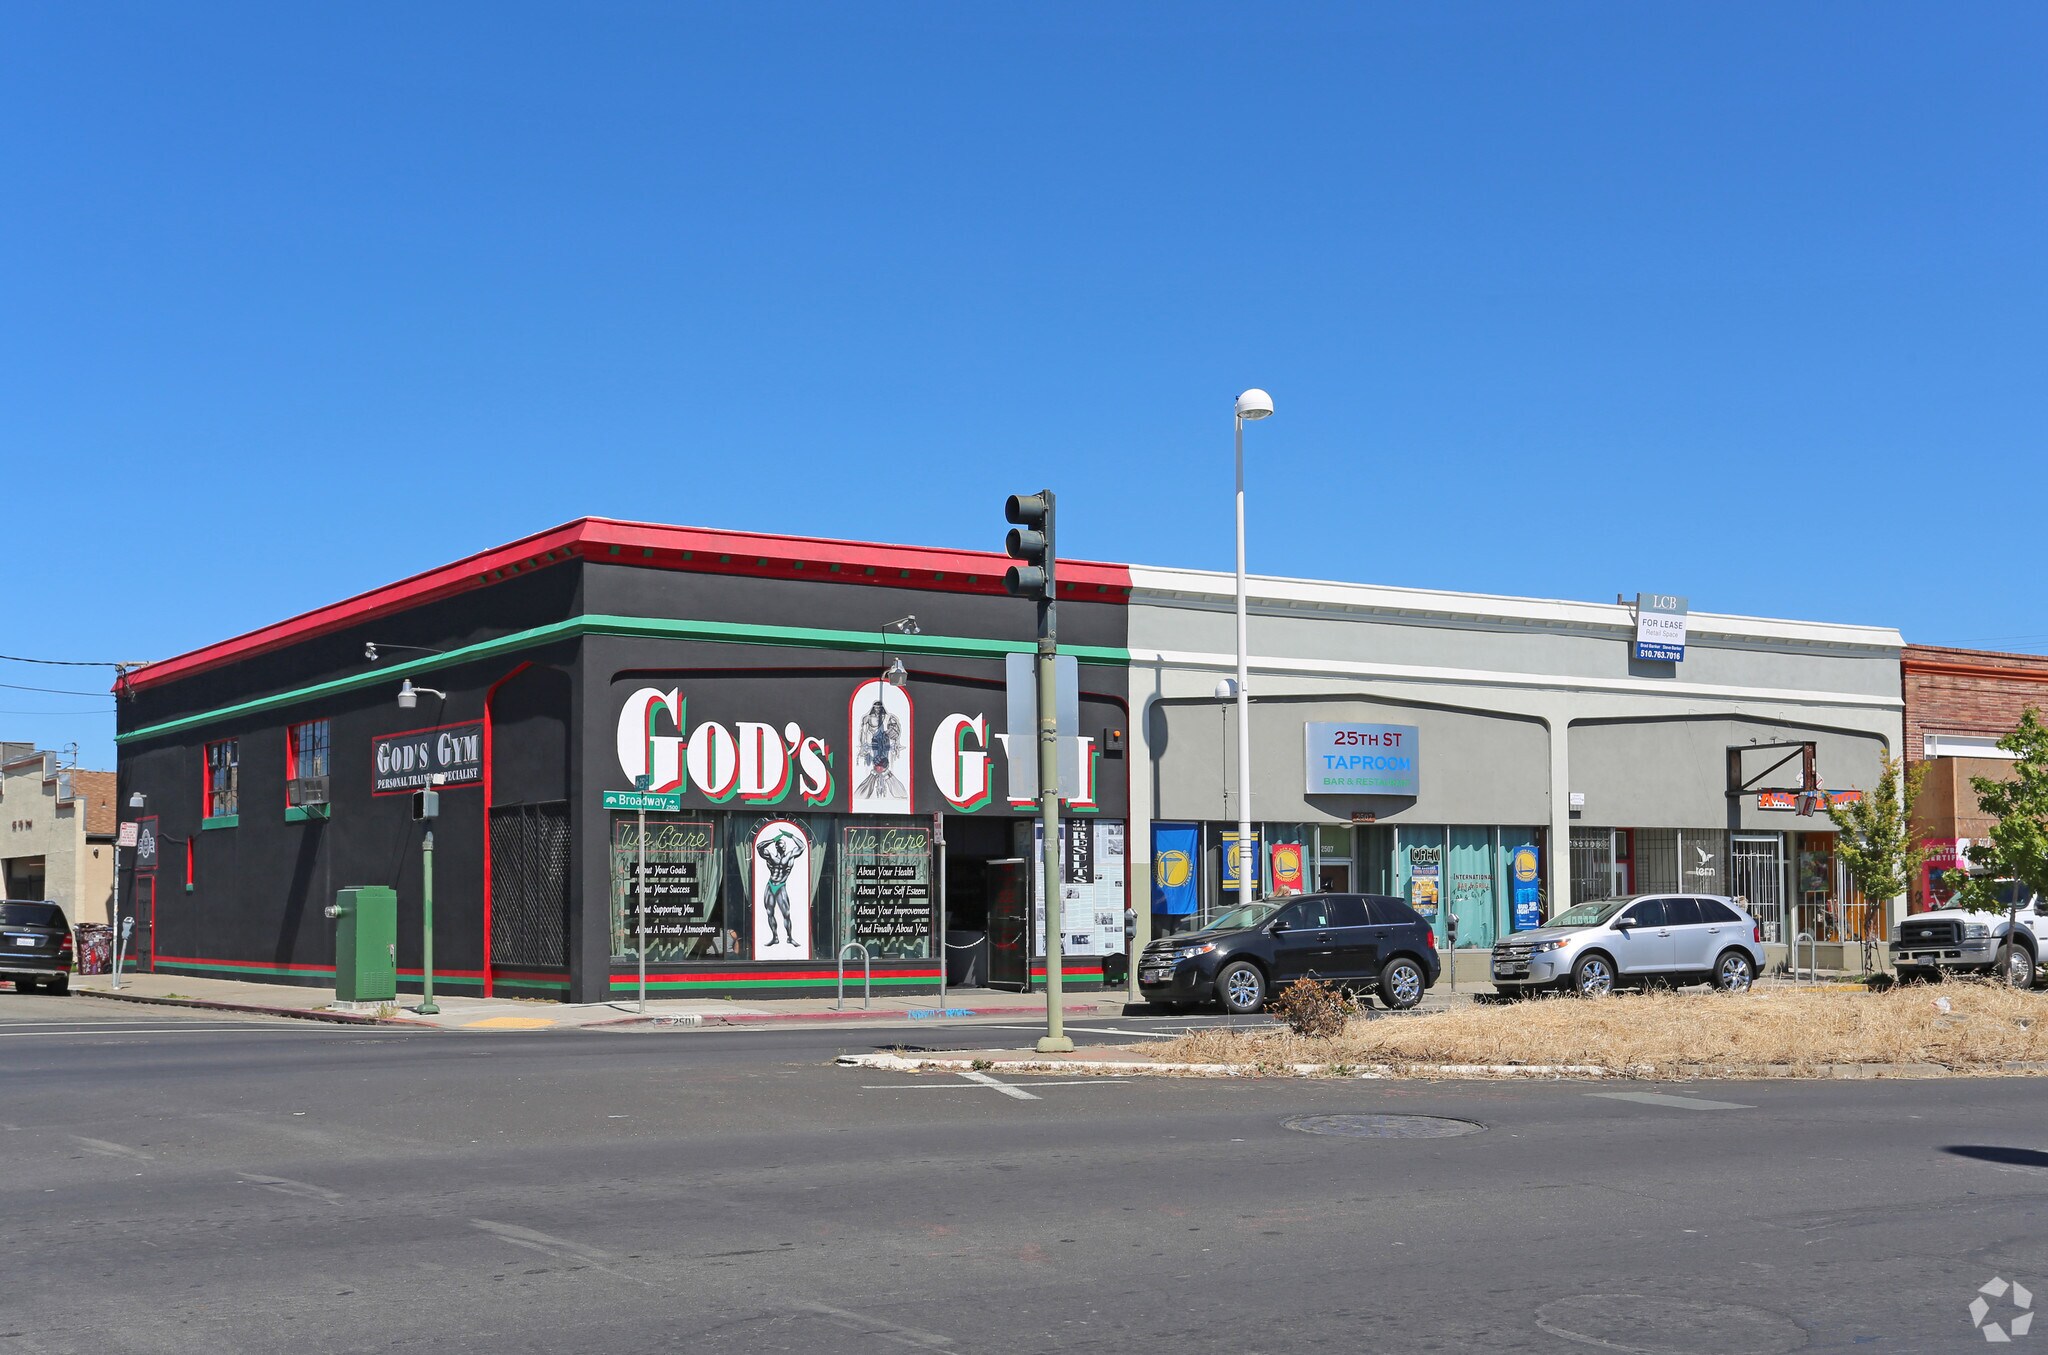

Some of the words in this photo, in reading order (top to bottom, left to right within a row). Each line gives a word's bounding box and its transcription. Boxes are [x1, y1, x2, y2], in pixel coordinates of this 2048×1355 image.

[1653, 595, 1676, 608] LCB
[1642, 618, 1658, 628] FOR
[1660, 620, 1683, 630] LEASE
[1662, 630, 1679, 639] Space
[1640, 650, 1681, 660] 510.763.7016
[617, 687, 827, 796] GOD'S
[1334, 731, 1378, 746] 25TH
[1383, 733, 1402, 747] ST
[377, 743, 428, 773] GOD'S
[437, 733, 478, 765] GYM
[1323, 755, 1411, 771] TAPROOM
[377, 776, 408, 789] PERSONAL
[1323, 777, 1345, 786] BAR
[619, 794, 667, 809] Broadway
[656, 825, 709, 848] Care
[849, 829, 878, 852] We
[883, 829, 927, 853] Care
[1072, 831, 1088, 883] RESULTS
[1411, 848, 1439, 862] OPEN
[635, 866, 652, 874] Aout
[654, 865, 668, 876] Your
[670, 865, 686, 874] Goals
[857, 866, 876, 876] About
[878, 866, 893, 879] Your
[894, 866, 914, 876] Health
[1696, 866, 1716, 876] tern
[635, 885, 652, 894] Aout
[654, 884, 668, 896] Your
[670, 884, 690, 894] Success
[857, 886, 876, 895] About
[878, 886, 892, 898] Your
[894, 886, 906, 898] Self
[906, 886, 926, 895] Esteem
[634, 904, 652, 914] Aout
[653, 904, 682, 916] Supporting
[683, 904, 694, 916] You
[857, 906, 876, 915] About
[878, 906, 892, 918] Your
[894, 906, 930, 918] Improvement
[635, 925, 652, 934] Aout
[654, 925, 658, 934] A
[660, 924, 682, 936] Friendly
[684, 924, 716, 935] Atmosphere
[858, 924, 872, 934] And
[874, 924, 894, 936] Finally
[895, 924, 913, 933] About
[915, 924, 928, 936] You
[673, 1018, 694, 1027] 2501
